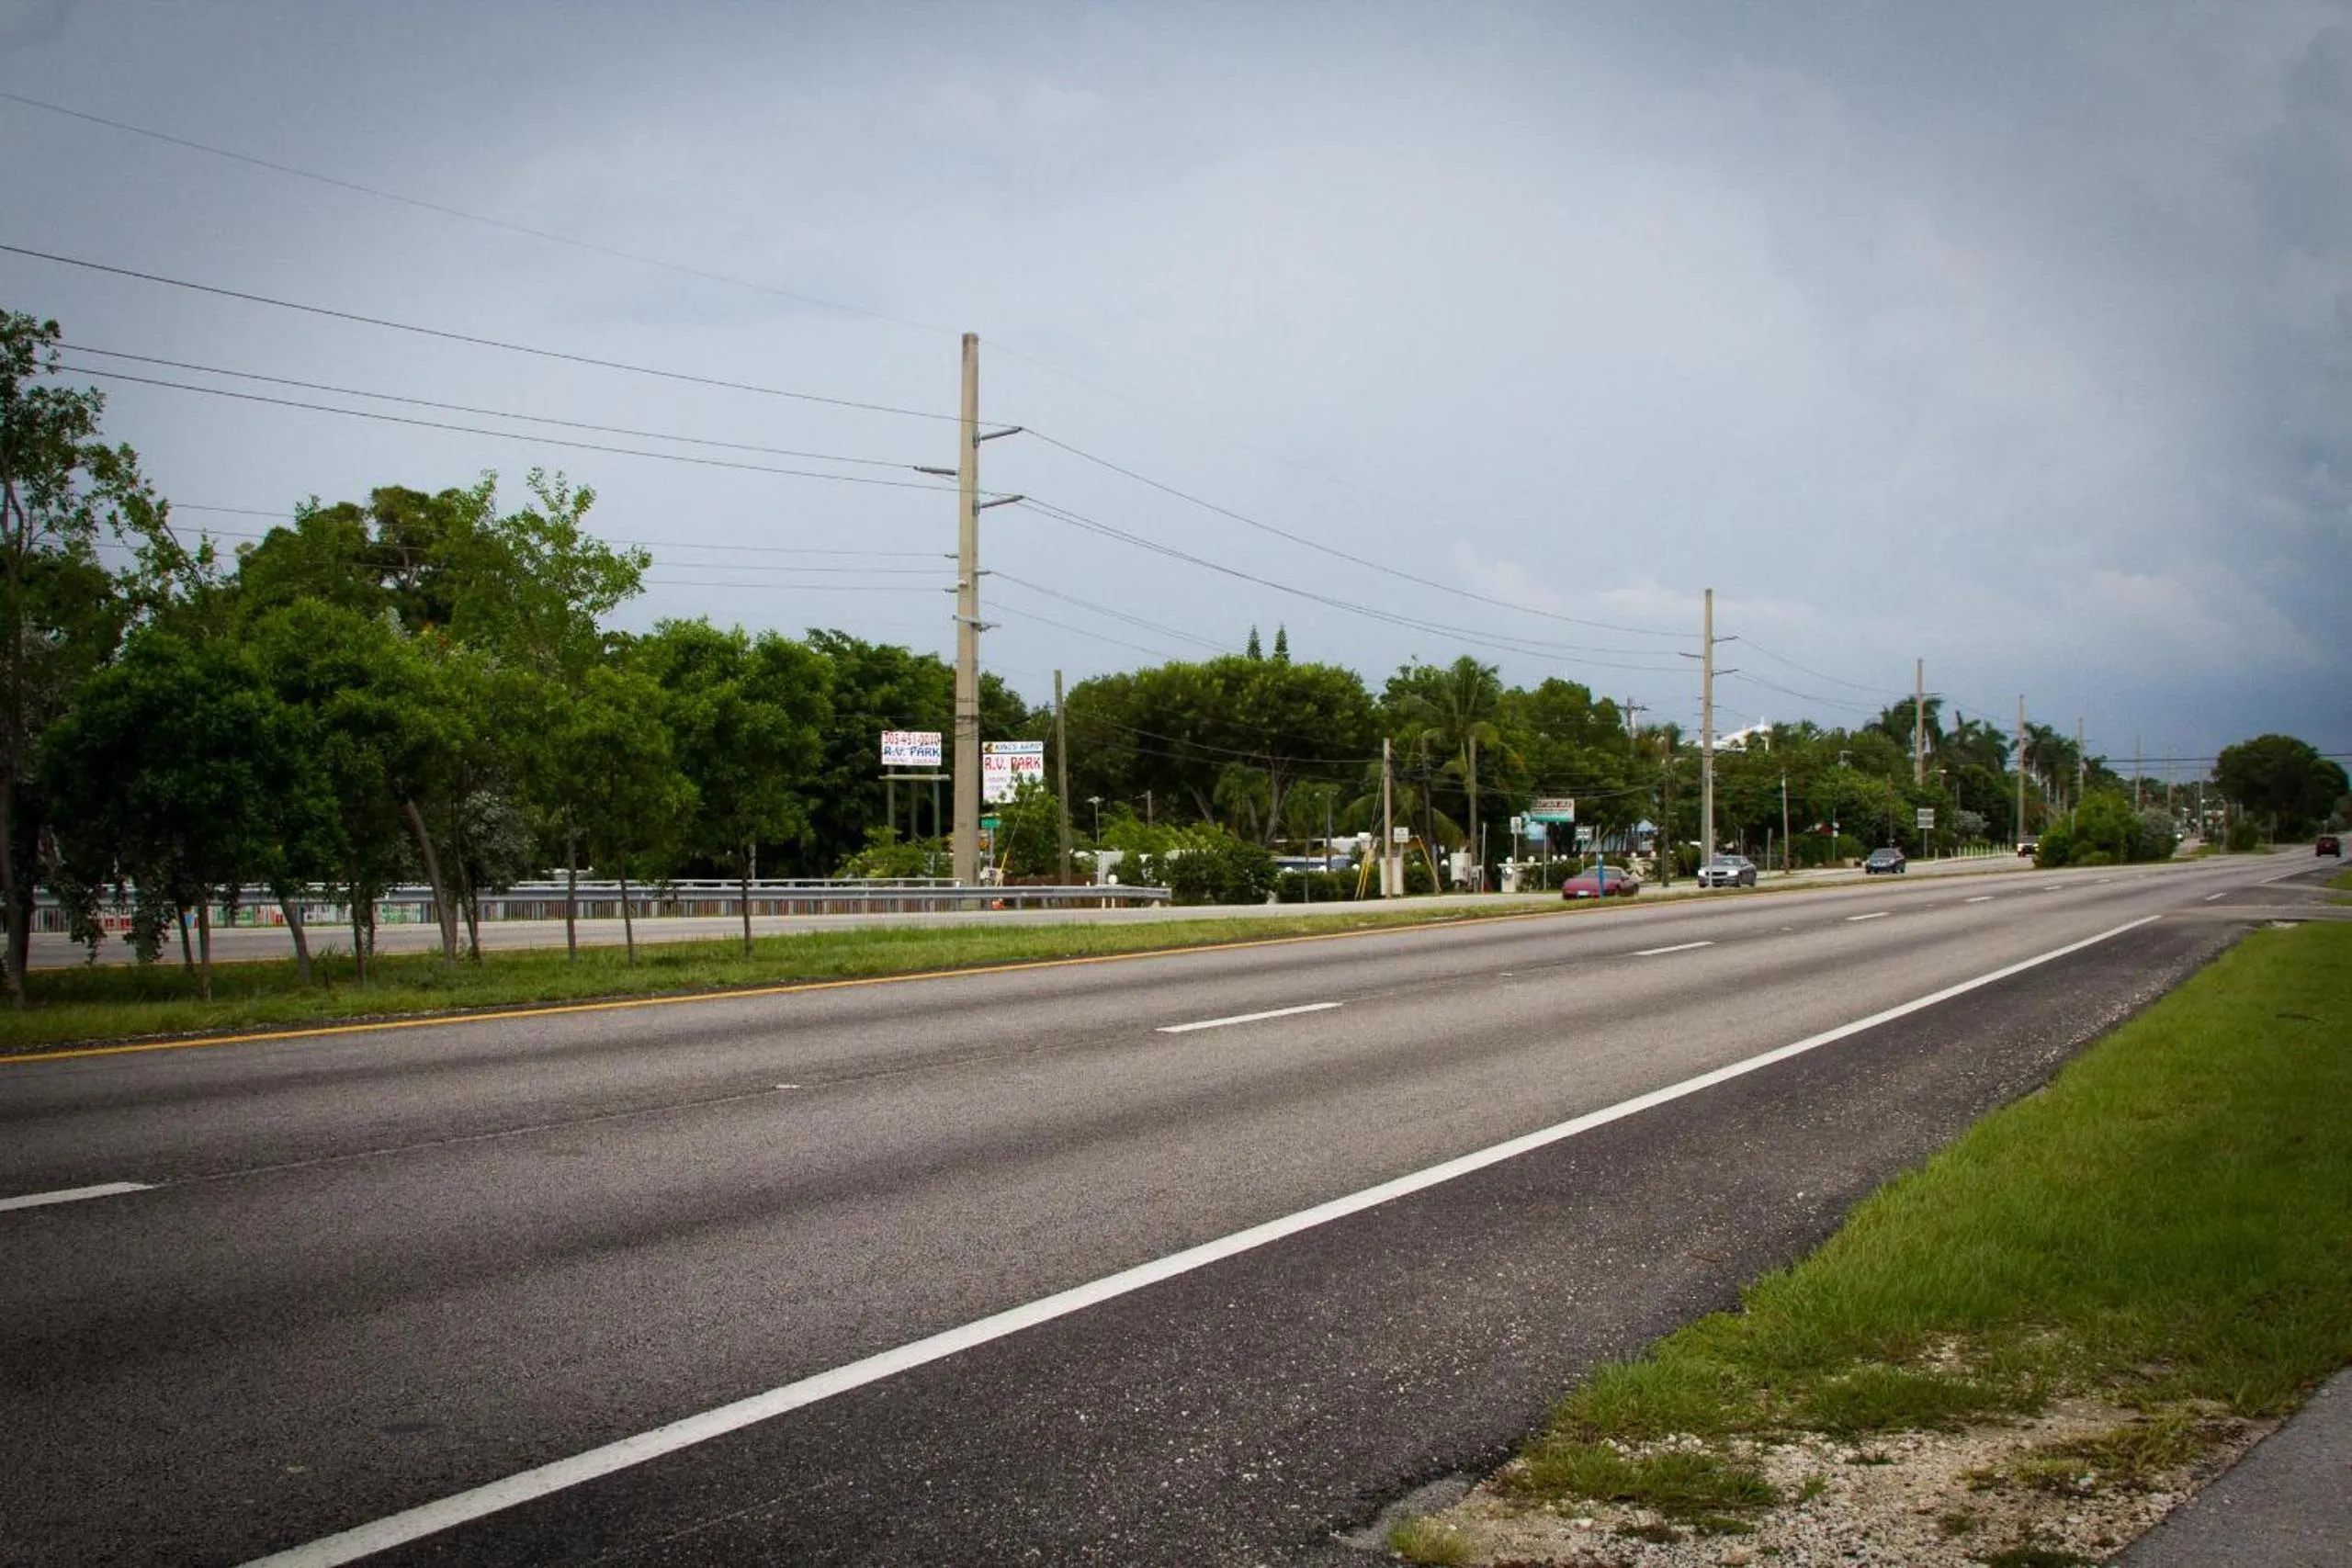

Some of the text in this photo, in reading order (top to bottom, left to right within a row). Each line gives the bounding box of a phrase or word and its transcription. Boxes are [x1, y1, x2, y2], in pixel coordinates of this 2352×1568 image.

[910, 746, 940, 757] PARK
[985, 756, 1040, 770] R.V. PARK
